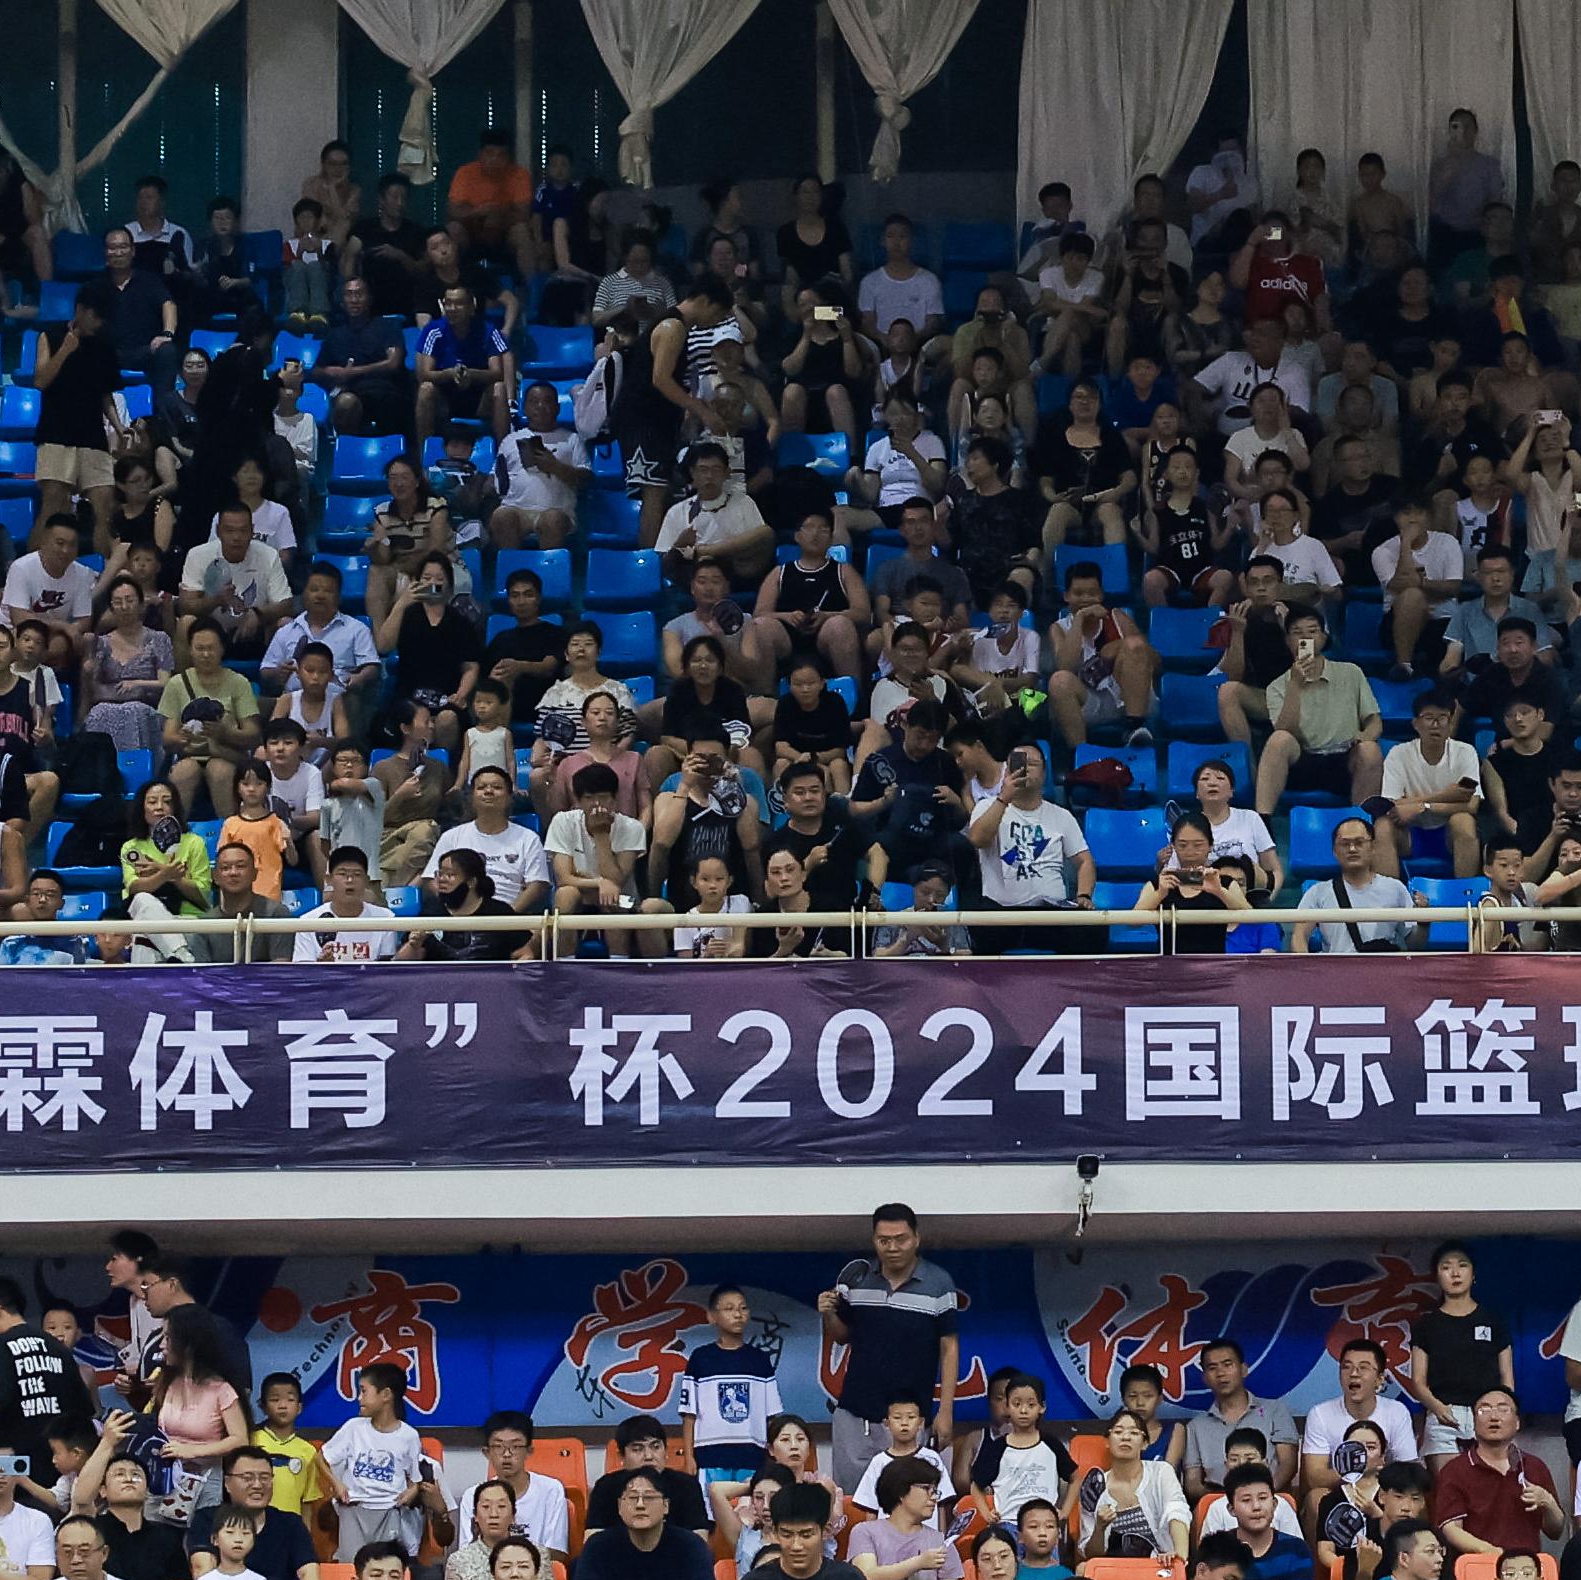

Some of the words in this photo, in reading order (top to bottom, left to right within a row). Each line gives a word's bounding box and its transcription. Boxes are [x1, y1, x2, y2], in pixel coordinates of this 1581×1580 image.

[6, 1336, 47, 1356] DON'T
[14, 1356, 63, 1377] FOLLOW
[18, 1376, 46, 1396] THE
[20, 1396, 61, 1417] WAVE
